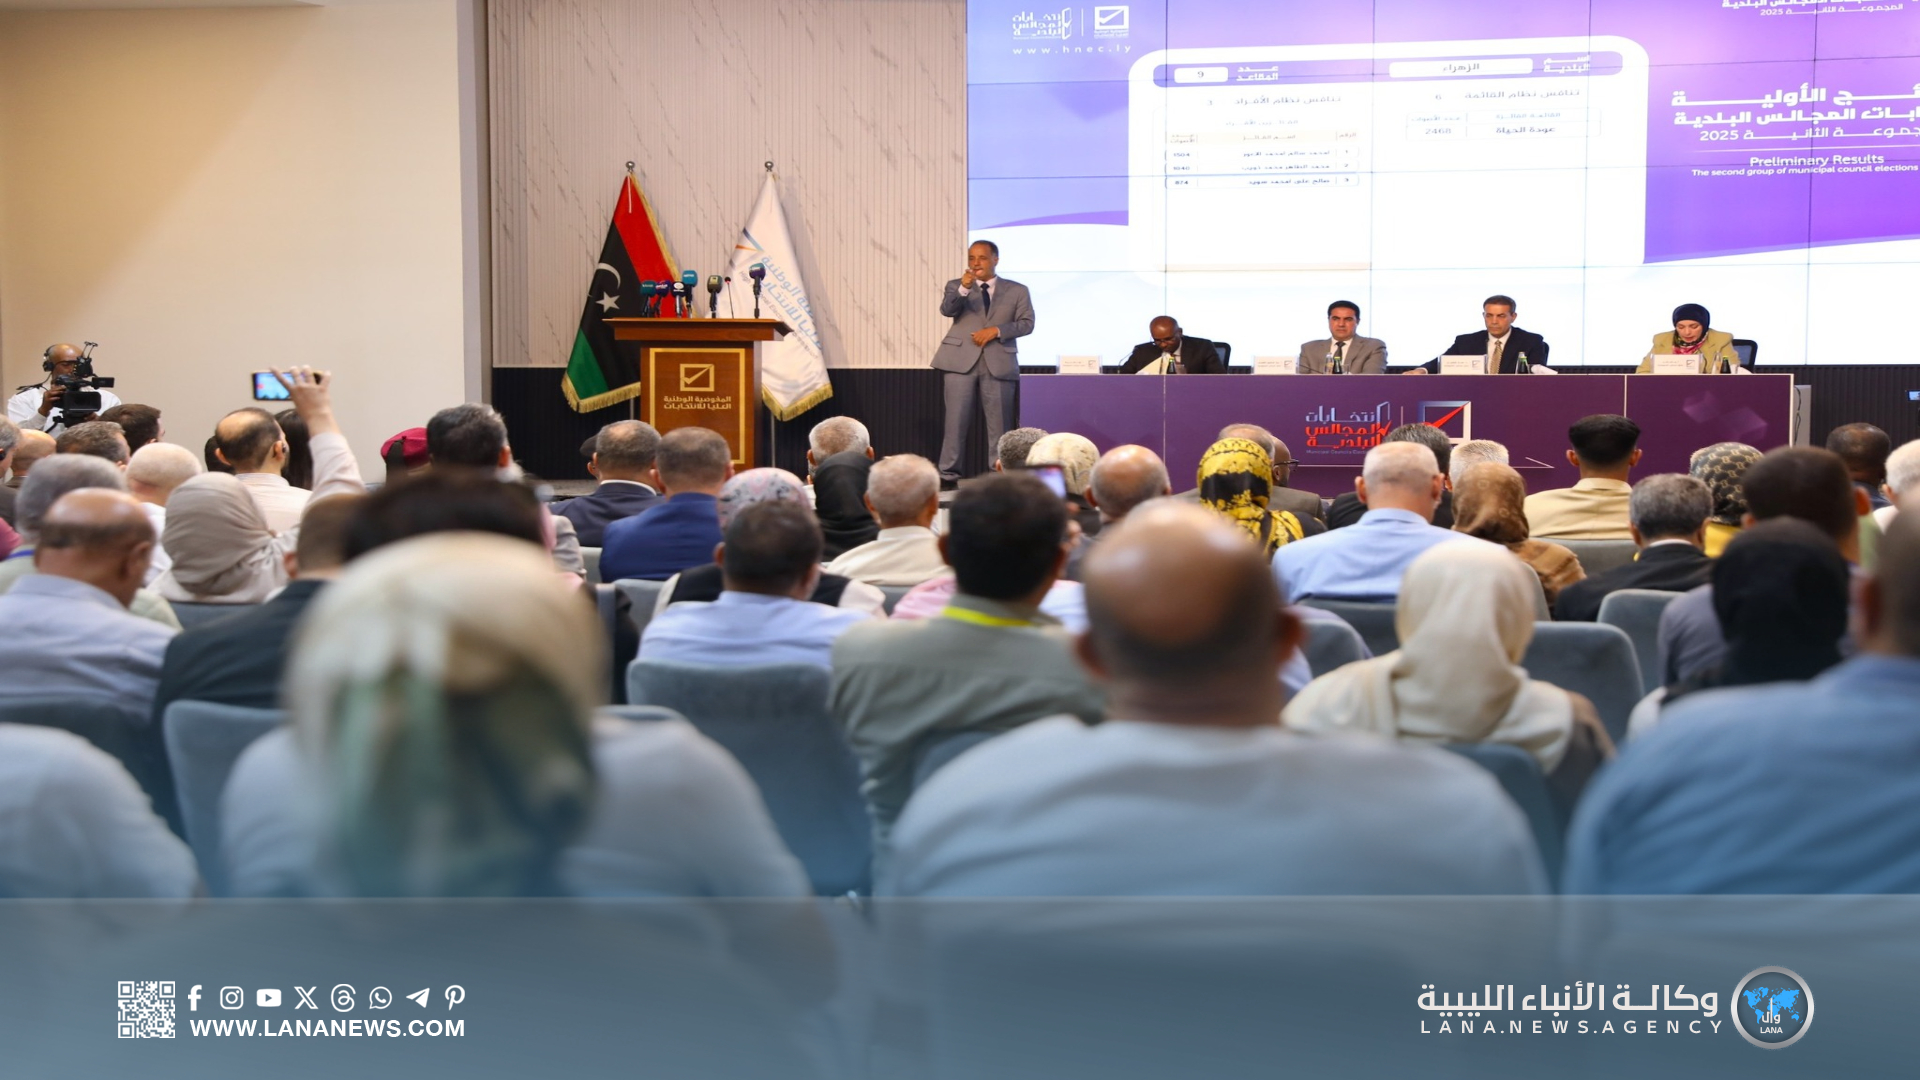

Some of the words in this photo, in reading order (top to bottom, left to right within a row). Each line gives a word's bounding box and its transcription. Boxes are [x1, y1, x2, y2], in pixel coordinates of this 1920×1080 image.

[1760, 8, 1783, 16] 2025
[1012, 44, 1131, 54] www.hnec.ly
[1238, 65, 1278, 73] عدد
[1443, 63, 1480, 73] الزهراء
[1197, 70, 1205, 78] 9
[1464, 89, 1505, 100] القائمة
[1508, 89, 1537, 99] نظام
[1540, 88, 1580, 99] تنافس
[1671, 82, 1826, 108] الأولية
[1272, 96, 1300, 106] نظام
[1674, 111, 1751, 128] البلدية
[1756, 108, 1856, 125] المجالس
[1861, 106, 1920, 122] ابات
[1495, 126, 1527, 135] الحياة
[1529, 126, 1556, 134] عودة
[1700, 129, 1739, 141] 2025
[1743, 127, 1829, 141] الثانية
[1833, 126, 1920, 138] جموعة
[1749, 156, 1829, 167] Preliminary
[1832, 154, 1884, 165] Results
[1692, 168, 1709, 176] The
[1711, 168, 1745, 176] second
[1747, 168, 1774, 177] group
[1776, 166, 1786, 175] of
[1788, 165, 1835, 175] municipal
[1837, 164, 1873, 174] council
[1874, 163, 1919, 173] elections
[663, 395, 694, 404] الوطنية
[695, 395, 732, 404] المفوضية
[1305, 403, 1382, 425] انتخابات
[1305, 422, 1381, 437] المجالس
[1306, 433, 1381, 449] البلدية
